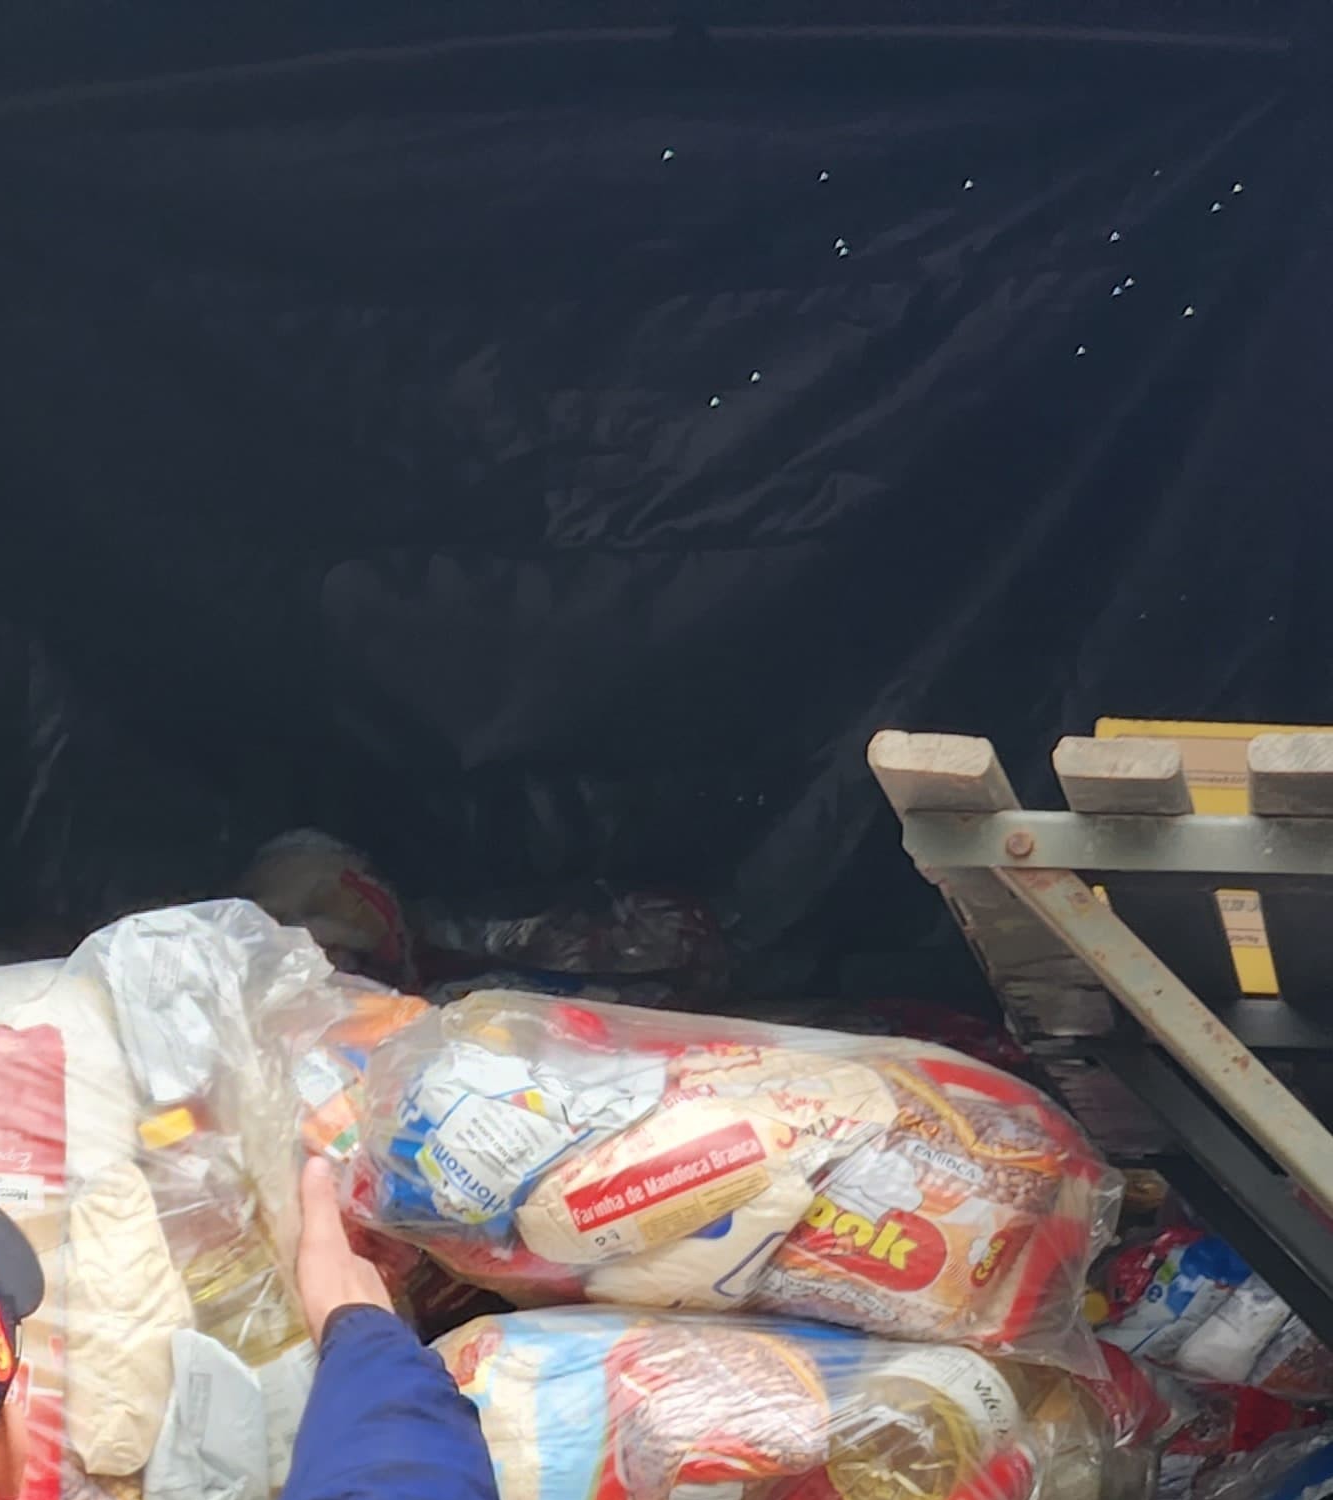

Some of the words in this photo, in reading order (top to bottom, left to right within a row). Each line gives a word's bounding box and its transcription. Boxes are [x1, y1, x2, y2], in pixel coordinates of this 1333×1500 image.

[571, 1195, 626, 1228] Farinha
[624, 1184, 646, 1207] de
[644, 1159, 713, 1200] Mandioca
[709, 1137, 761, 1172] Branca
